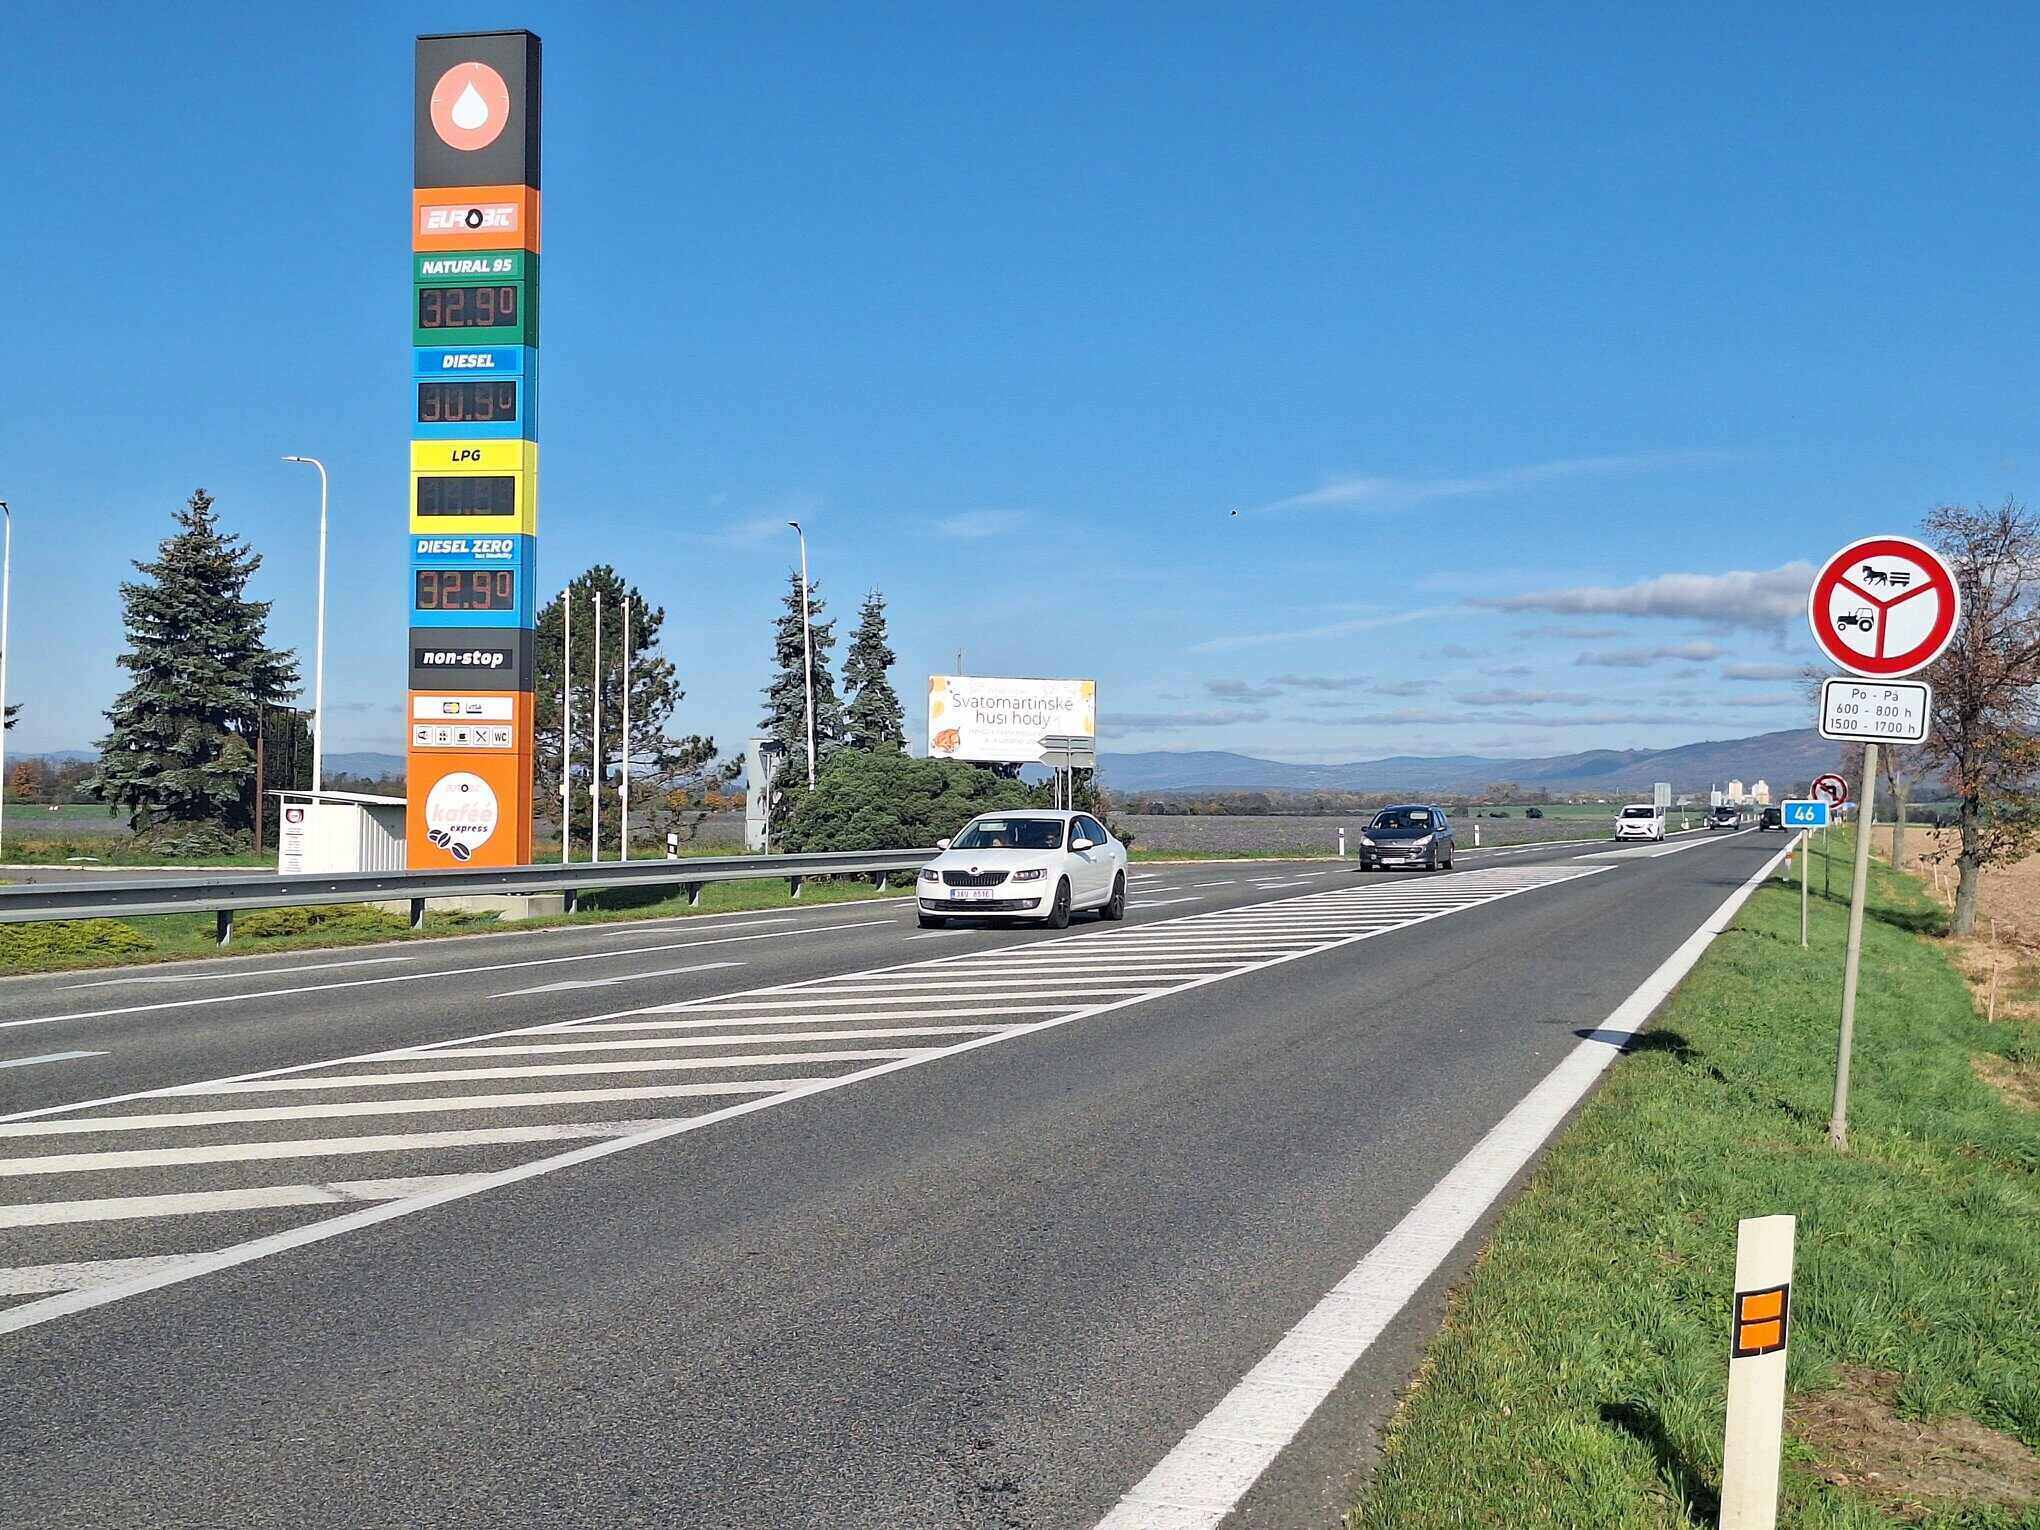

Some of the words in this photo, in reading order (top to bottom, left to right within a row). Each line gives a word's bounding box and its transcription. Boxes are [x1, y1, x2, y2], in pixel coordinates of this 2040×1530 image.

[422, 259, 490, 274] NATURAL
[493, 258, 513, 273] 95
[423, 287, 514, 327] 32.90
[442, 353, 495, 369] DIESEL
[452, 450, 481, 462] LPG
[417, 539, 469, 554] DIESEL
[471, 539, 513, 554] ZERO
[419, 571, 511, 609] 32.90
[423, 650, 504, 669] non-stop
[1851, 688, 1867, 700] Po
[1836, 703, 1859, 715] 600
[1876, 705, 1899, 717] 800
[1904, 708, 1912, 718] h
[1012, 711, 1051, 729] hody
[1830, 718, 1858, 730] 1500
[1875, 721, 1903, 733] 1700
[1908, 723, 1915, 734] h
[494, 732, 507, 742] WC
[1794, 806, 1815, 821] 46
[450, 824, 489, 834] express
